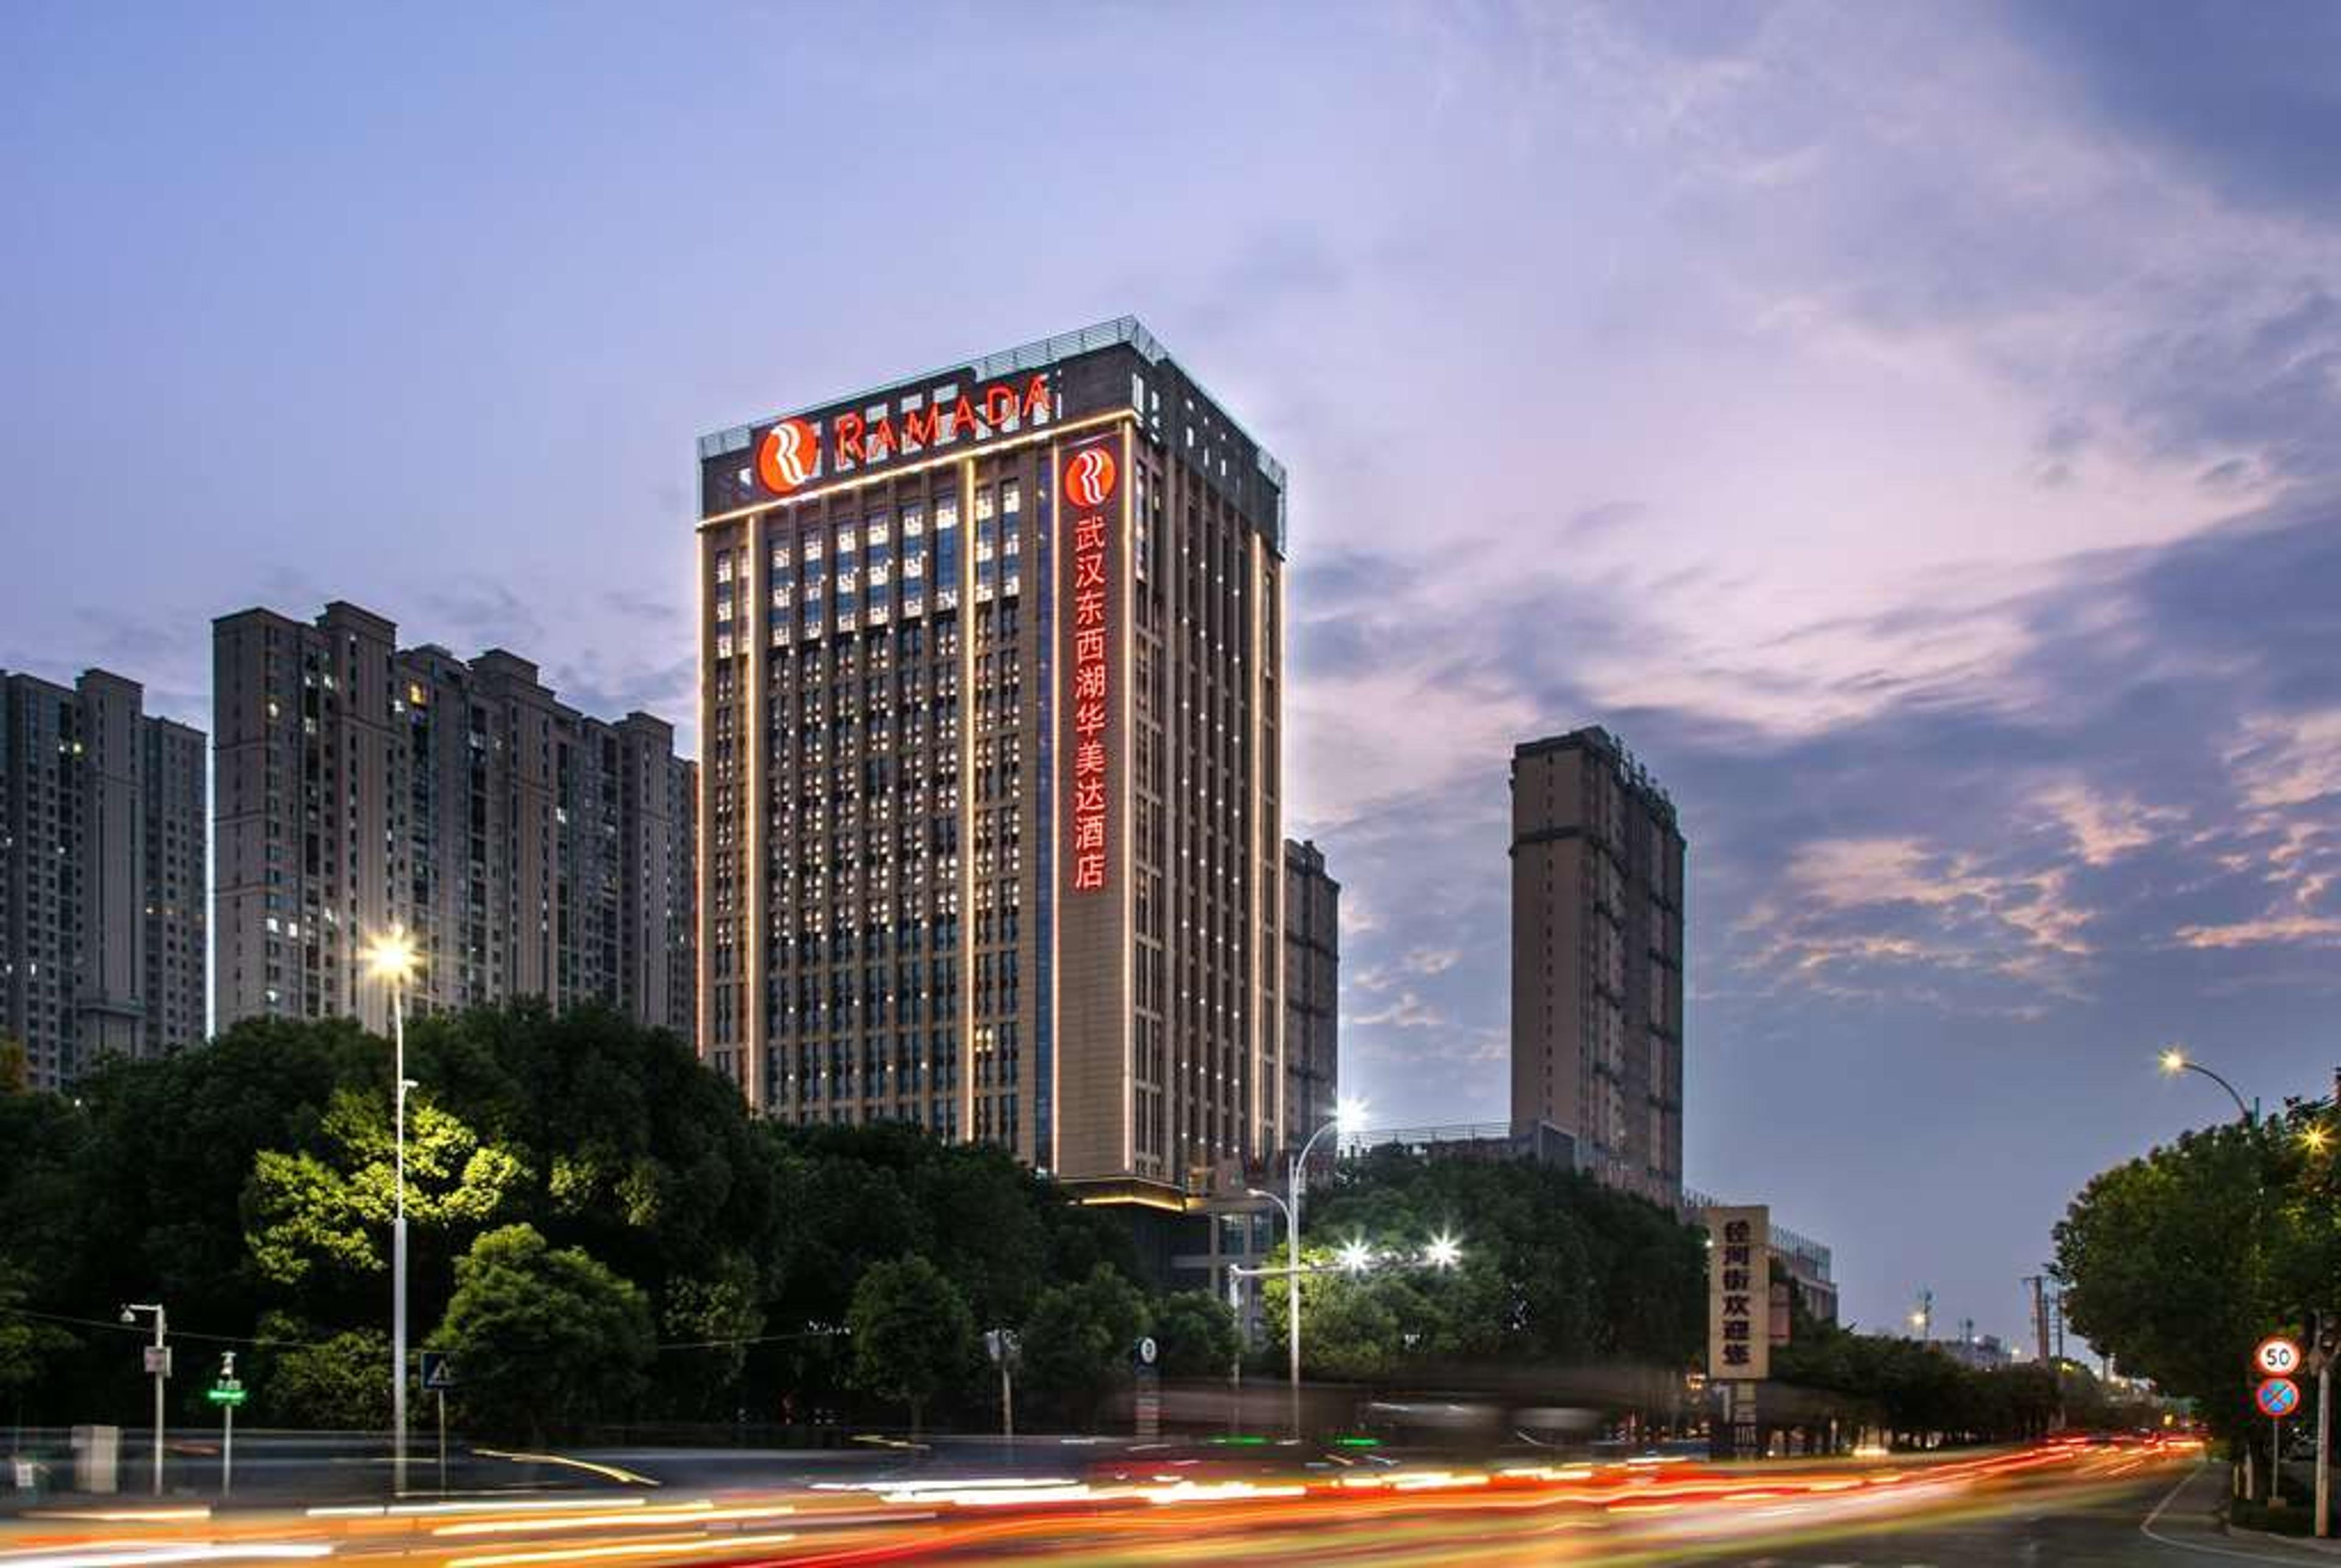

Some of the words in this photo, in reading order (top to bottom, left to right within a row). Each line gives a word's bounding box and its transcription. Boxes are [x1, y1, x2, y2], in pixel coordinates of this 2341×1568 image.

[834, 374, 1050, 465] RAMADA
[1075, 516, 1106, 890] 武汉东西湖华美达酒店
[2266, 1348, 2290, 1366] 50
